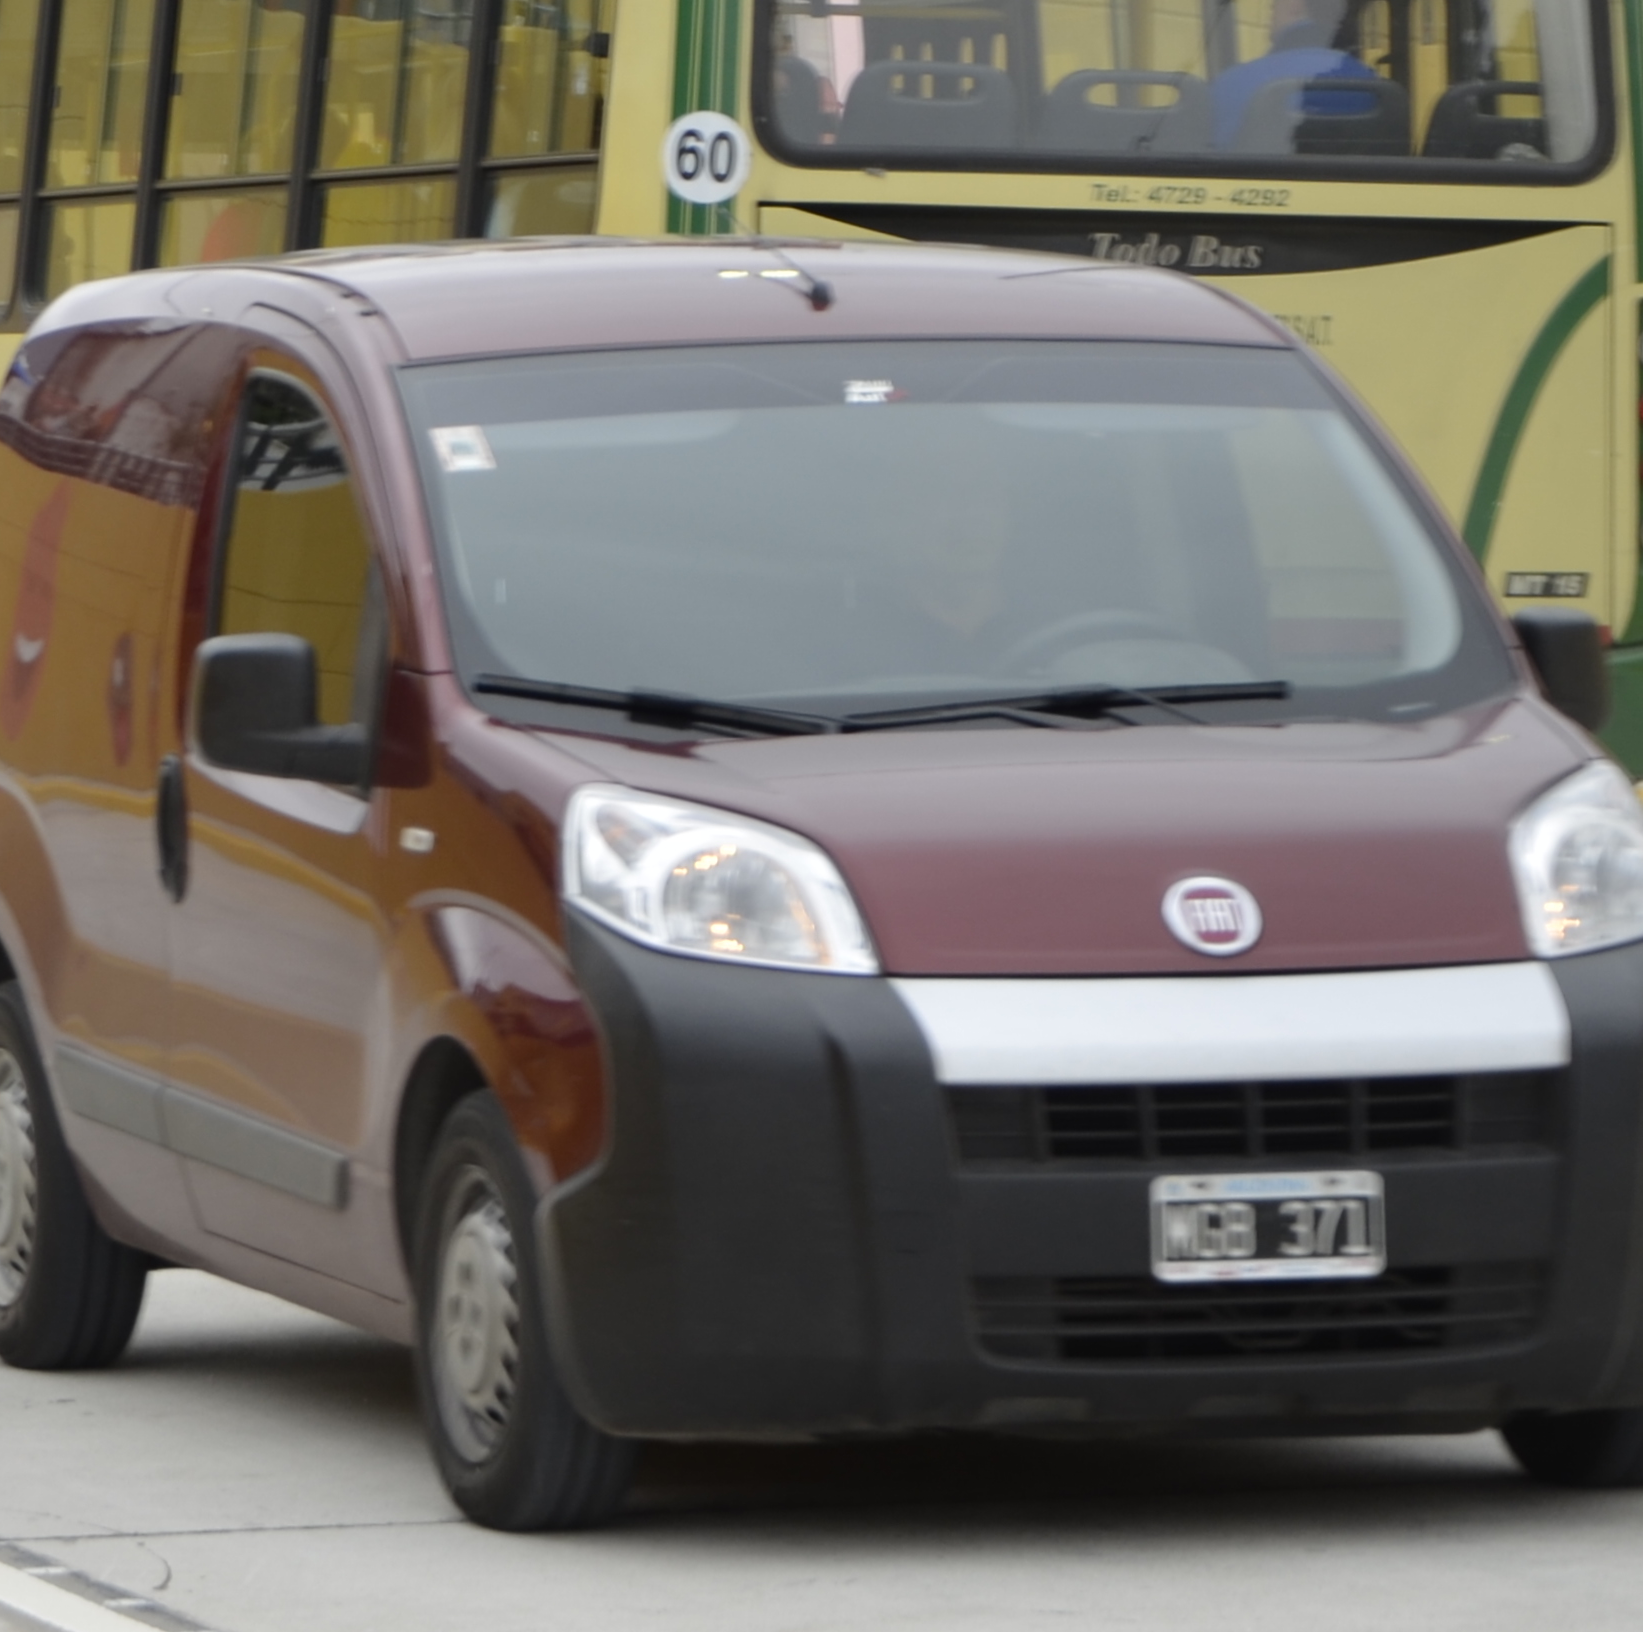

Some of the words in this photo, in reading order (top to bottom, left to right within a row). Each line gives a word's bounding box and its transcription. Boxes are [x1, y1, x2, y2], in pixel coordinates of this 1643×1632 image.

[677, 129, 736, 182] 60
[1088, 232, 1182, 266] Todo
[1185, 235, 1263, 268] Bus
[1278, 1199, 1371, 1256] 371
